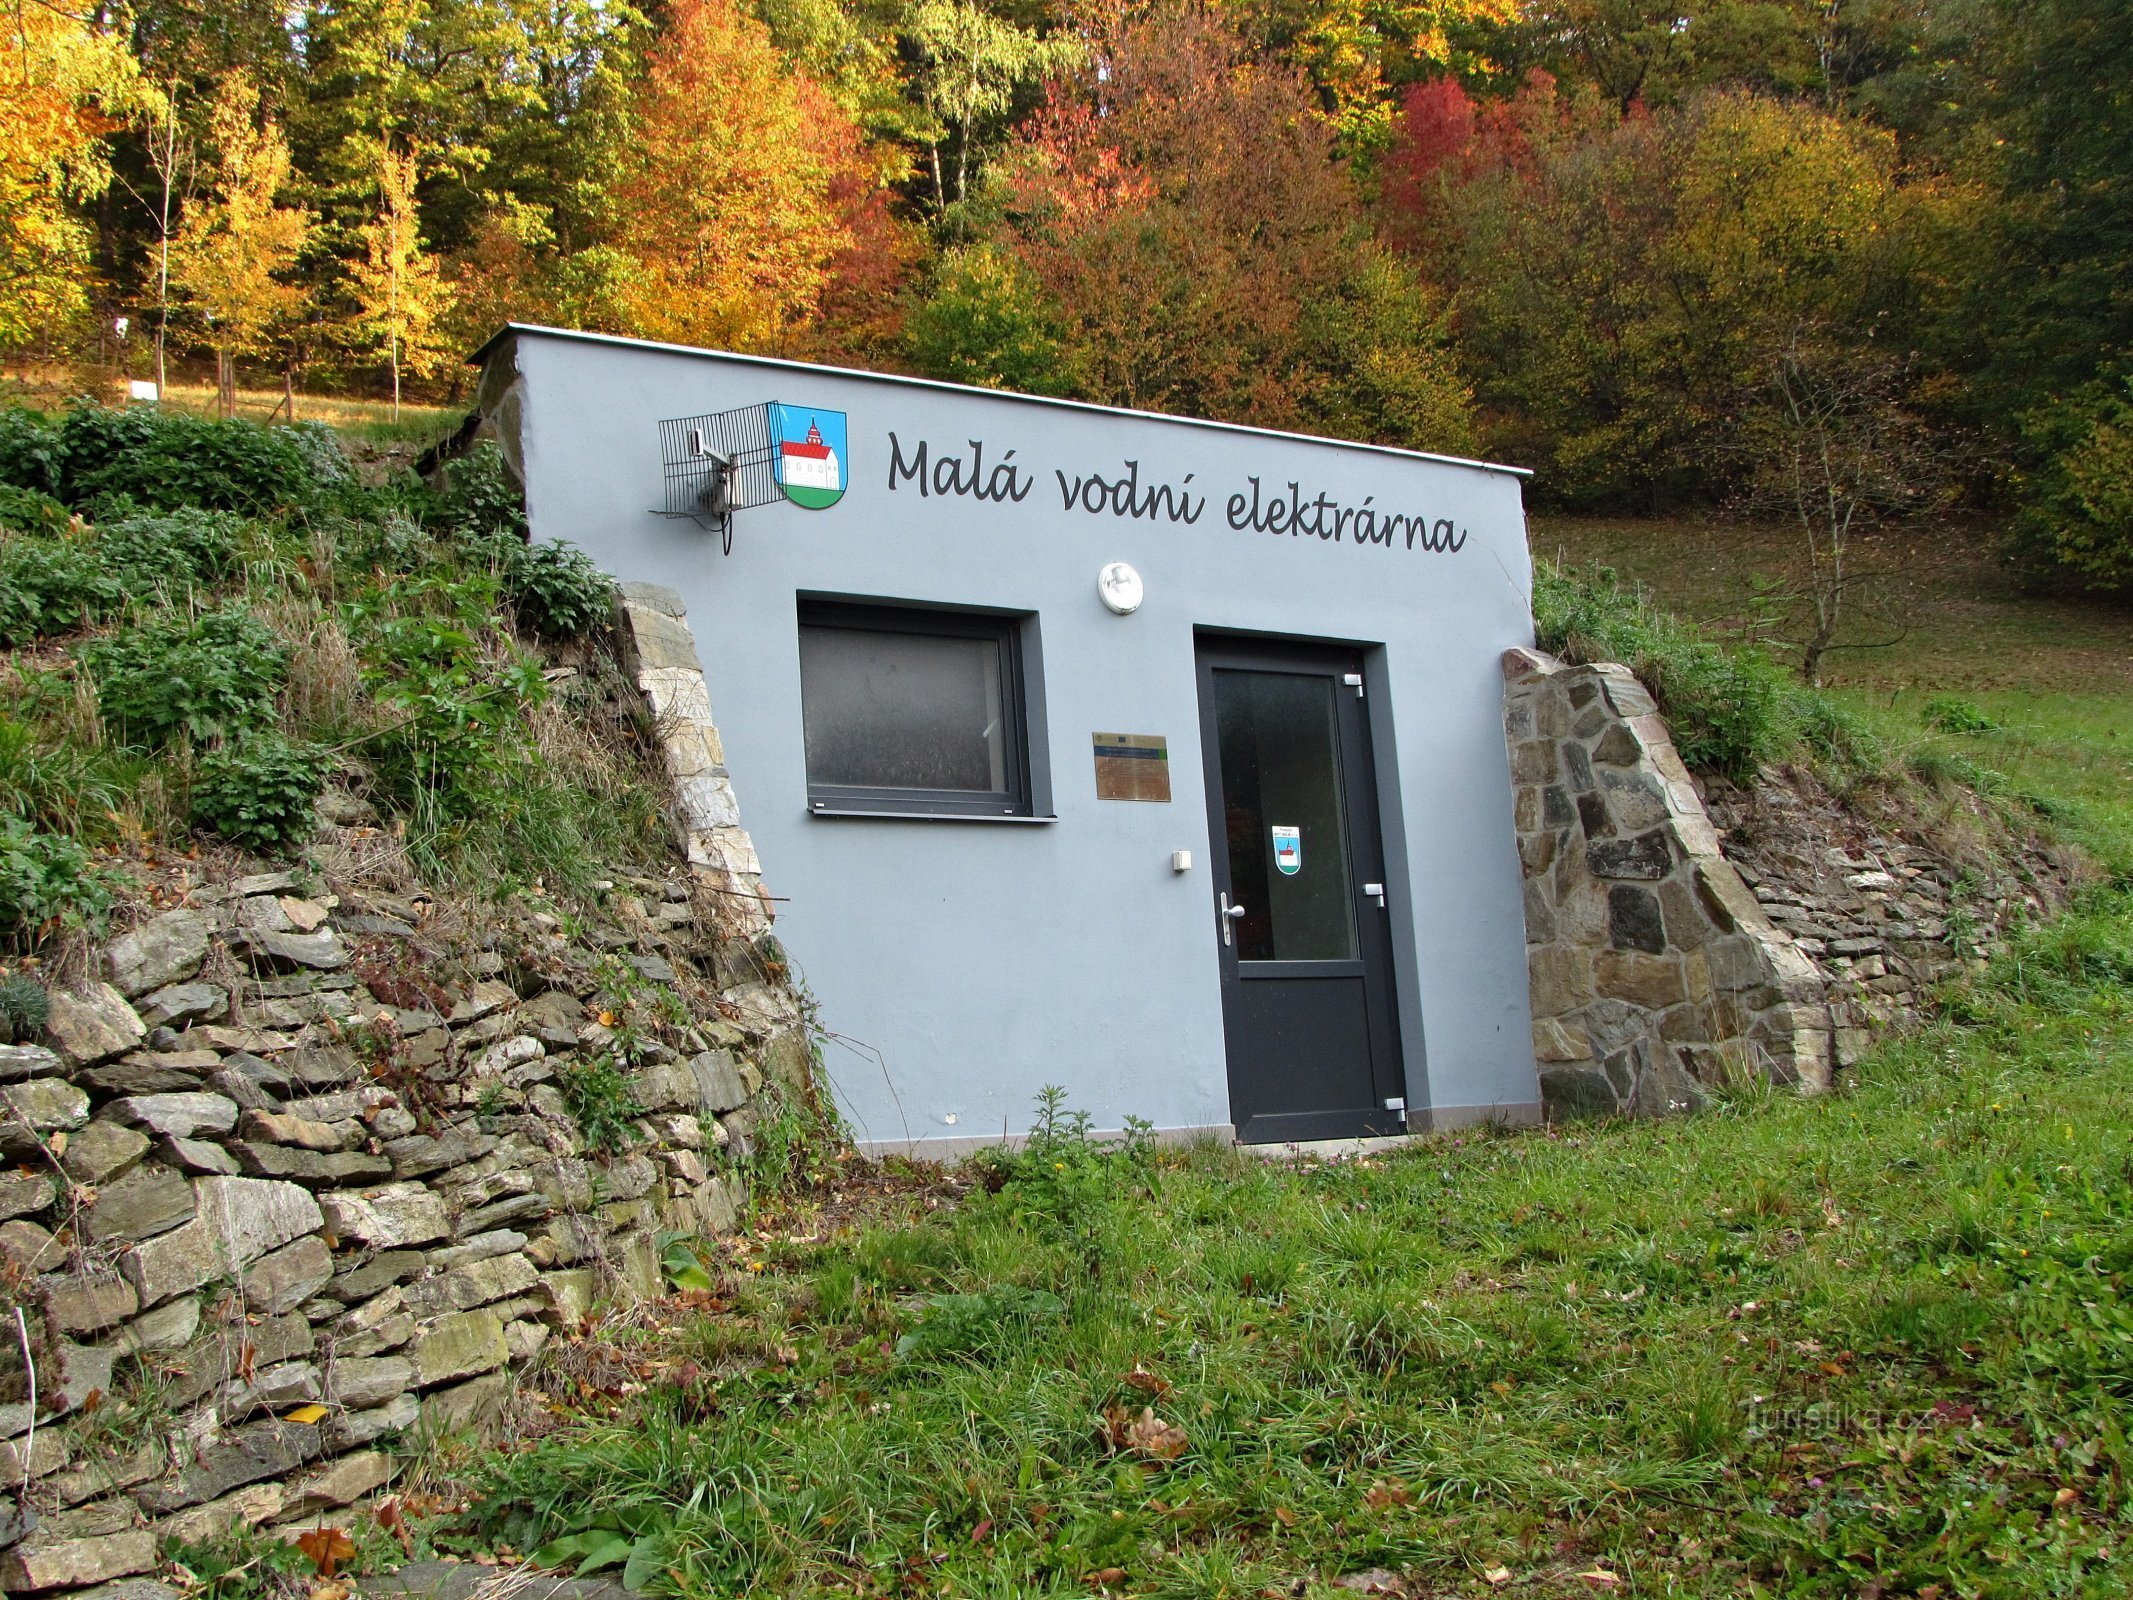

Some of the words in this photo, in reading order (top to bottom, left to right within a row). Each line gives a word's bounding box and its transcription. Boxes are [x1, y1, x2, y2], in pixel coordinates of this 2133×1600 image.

[888, 431, 1034, 503] Malá
[1055, 460, 1206, 525] vodní
[1226, 475, 1468, 554] elektrárna
